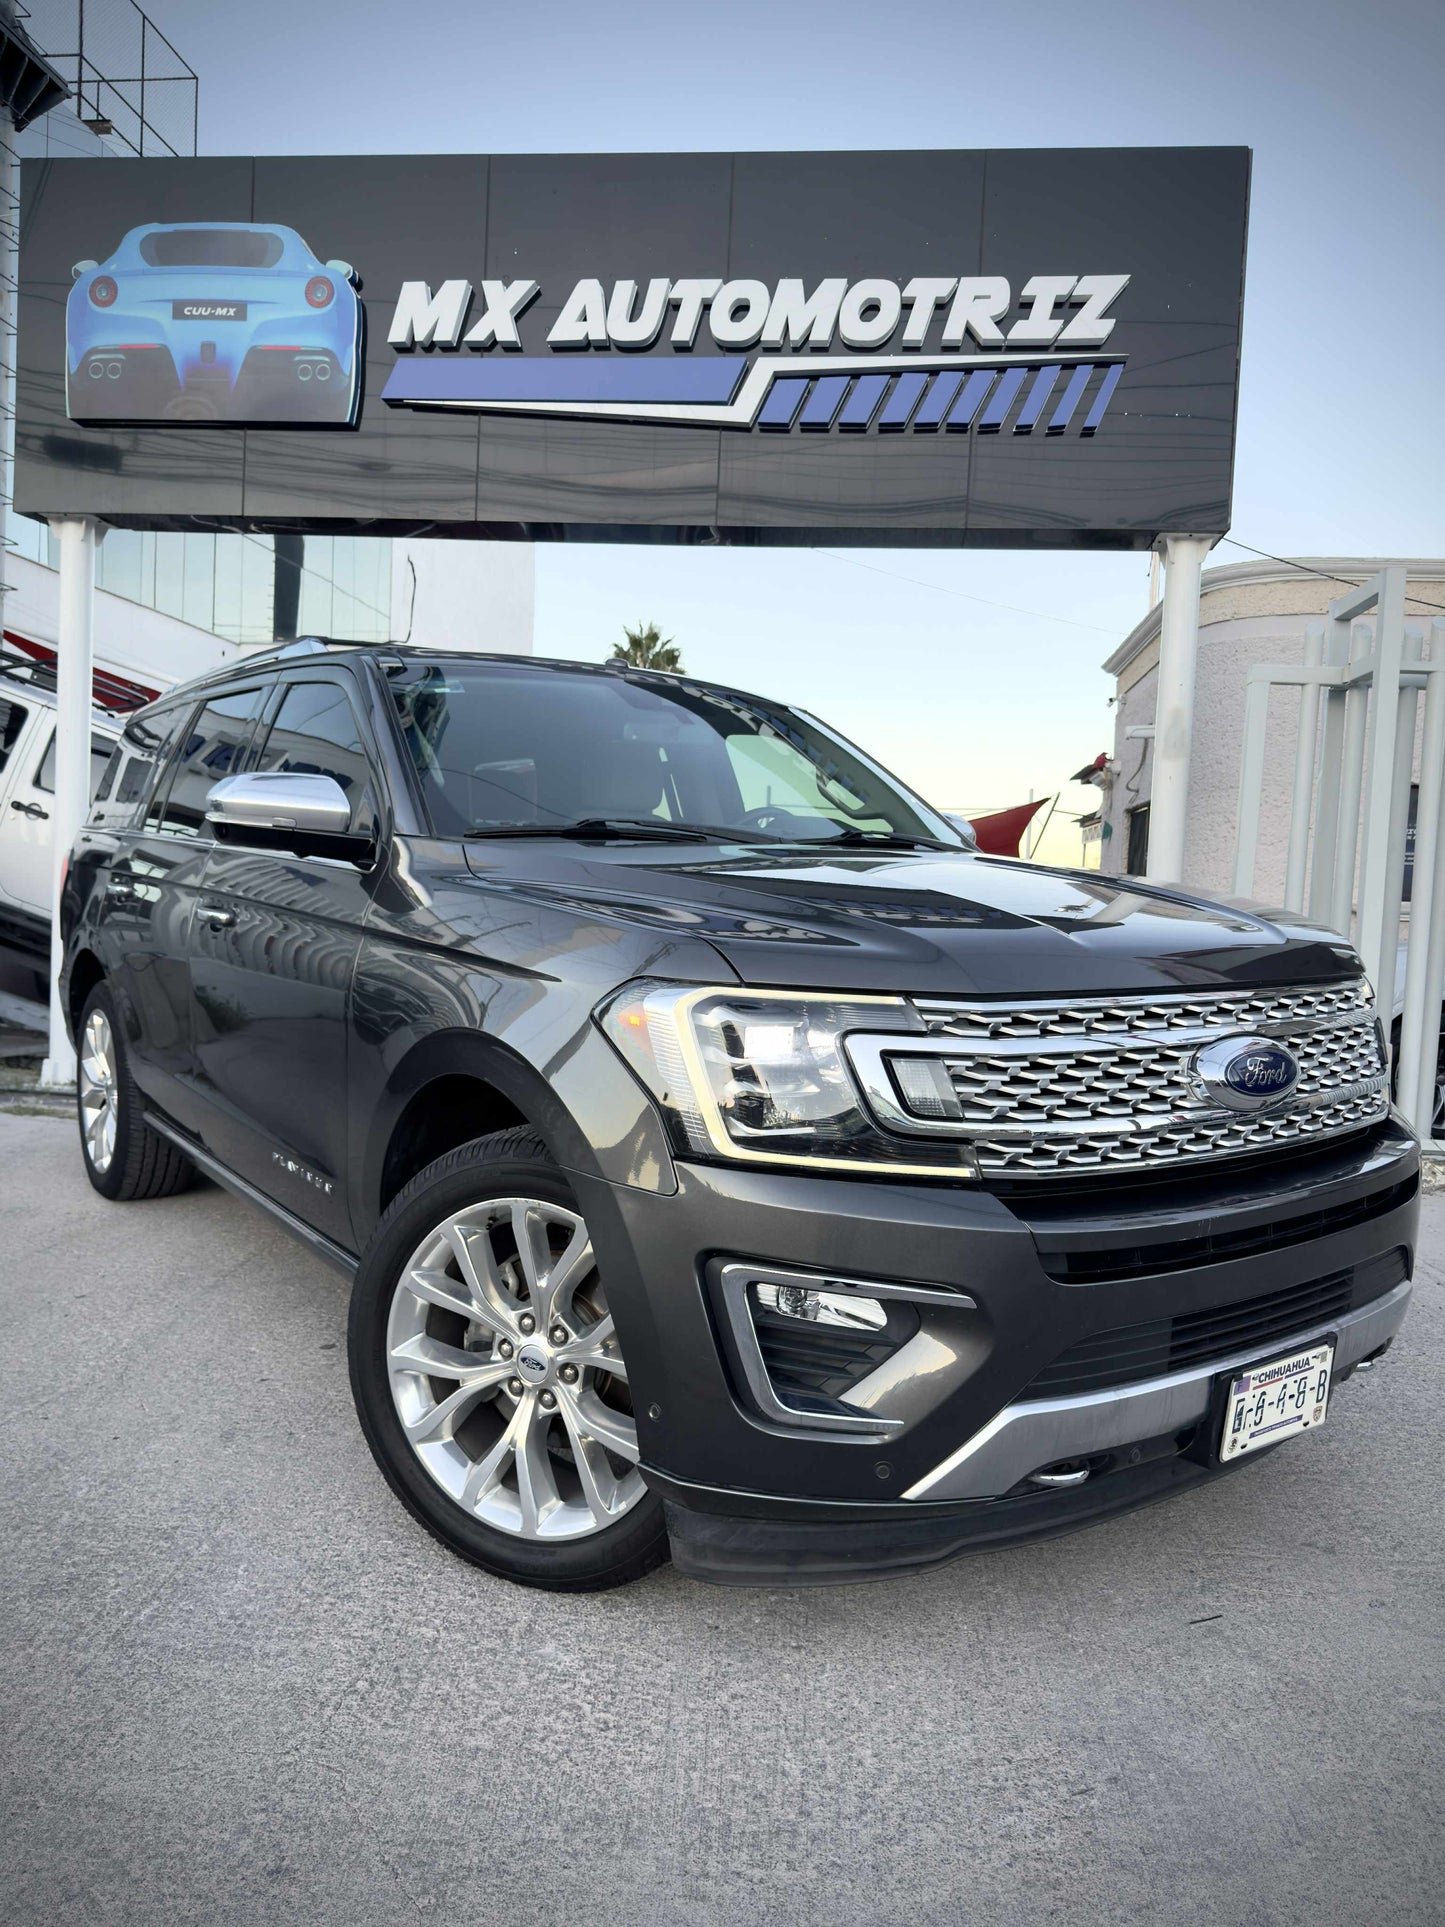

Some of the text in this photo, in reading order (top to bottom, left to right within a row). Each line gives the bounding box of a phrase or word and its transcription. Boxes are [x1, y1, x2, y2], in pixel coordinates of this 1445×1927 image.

[183, 306, 237, 317] CUU-MX
[387, 274, 1131, 348] MX AUTOMOTRIZ
[1244, 1056, 1287, 1088] Ford
[1258, 1357, 1310, 1383] CHIHUAHUA
